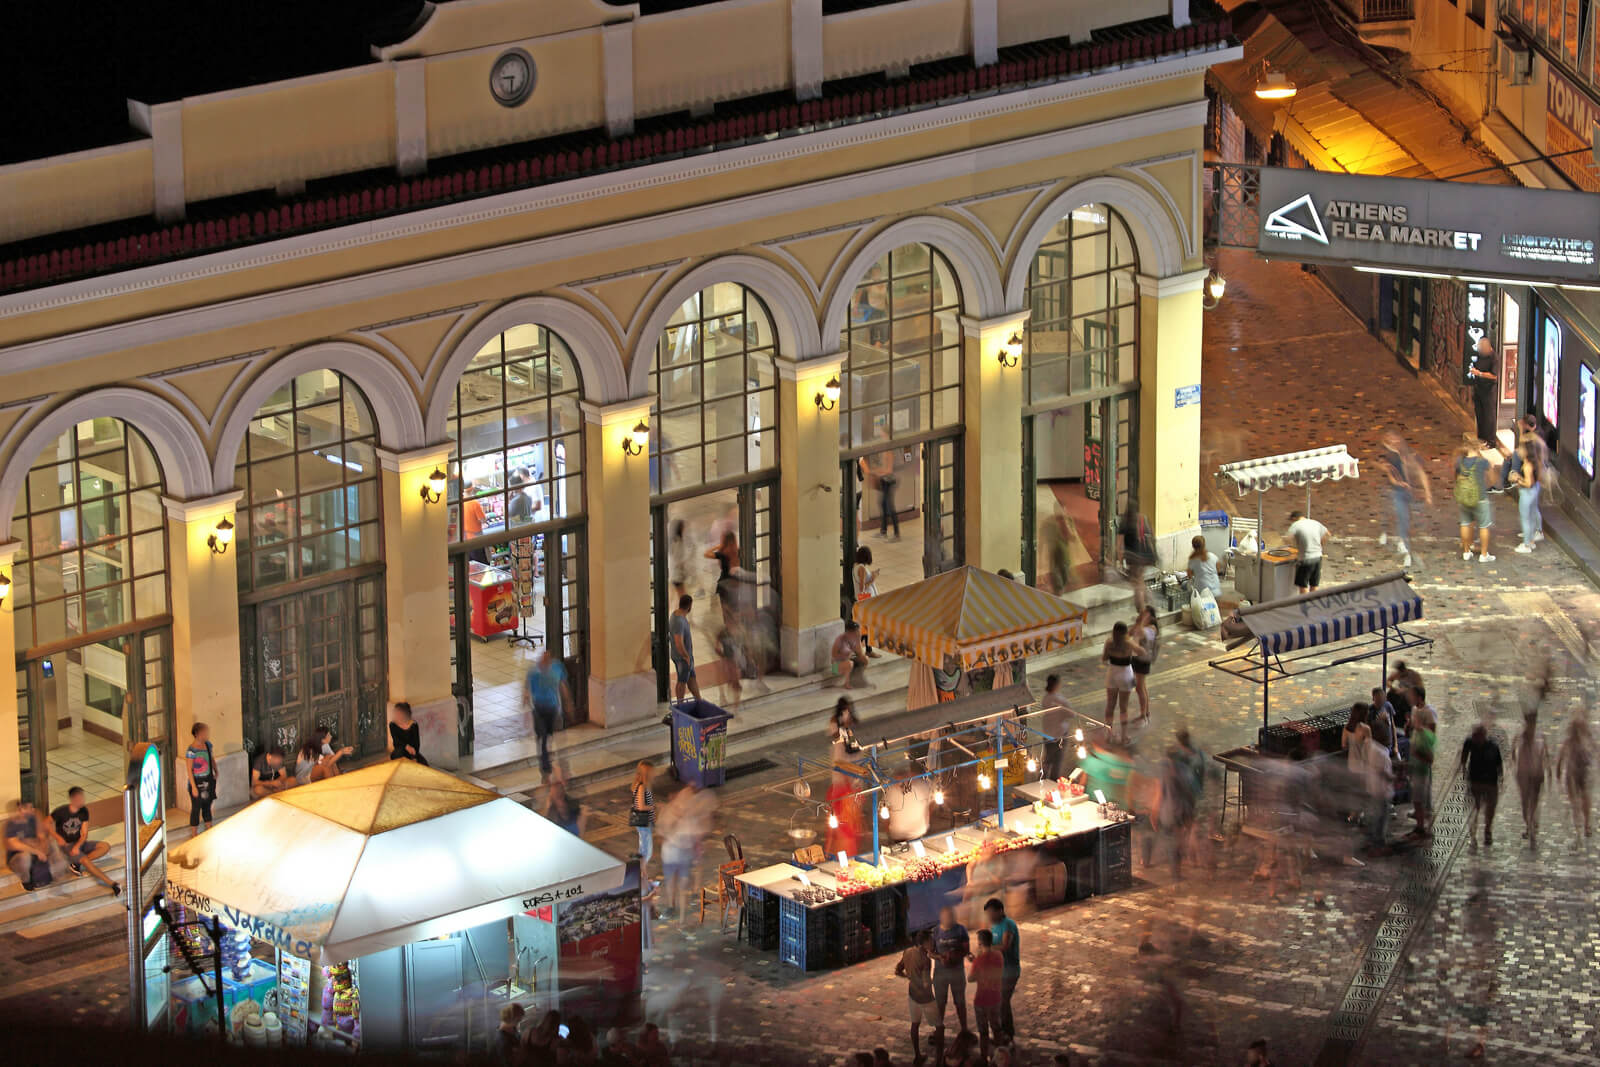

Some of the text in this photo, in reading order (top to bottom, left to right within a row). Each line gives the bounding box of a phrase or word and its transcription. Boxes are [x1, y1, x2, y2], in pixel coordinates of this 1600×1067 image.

[1325, 200, 1407, 223] ATHENS
[1332, 220, 1482, 250] FLEA MARKET
